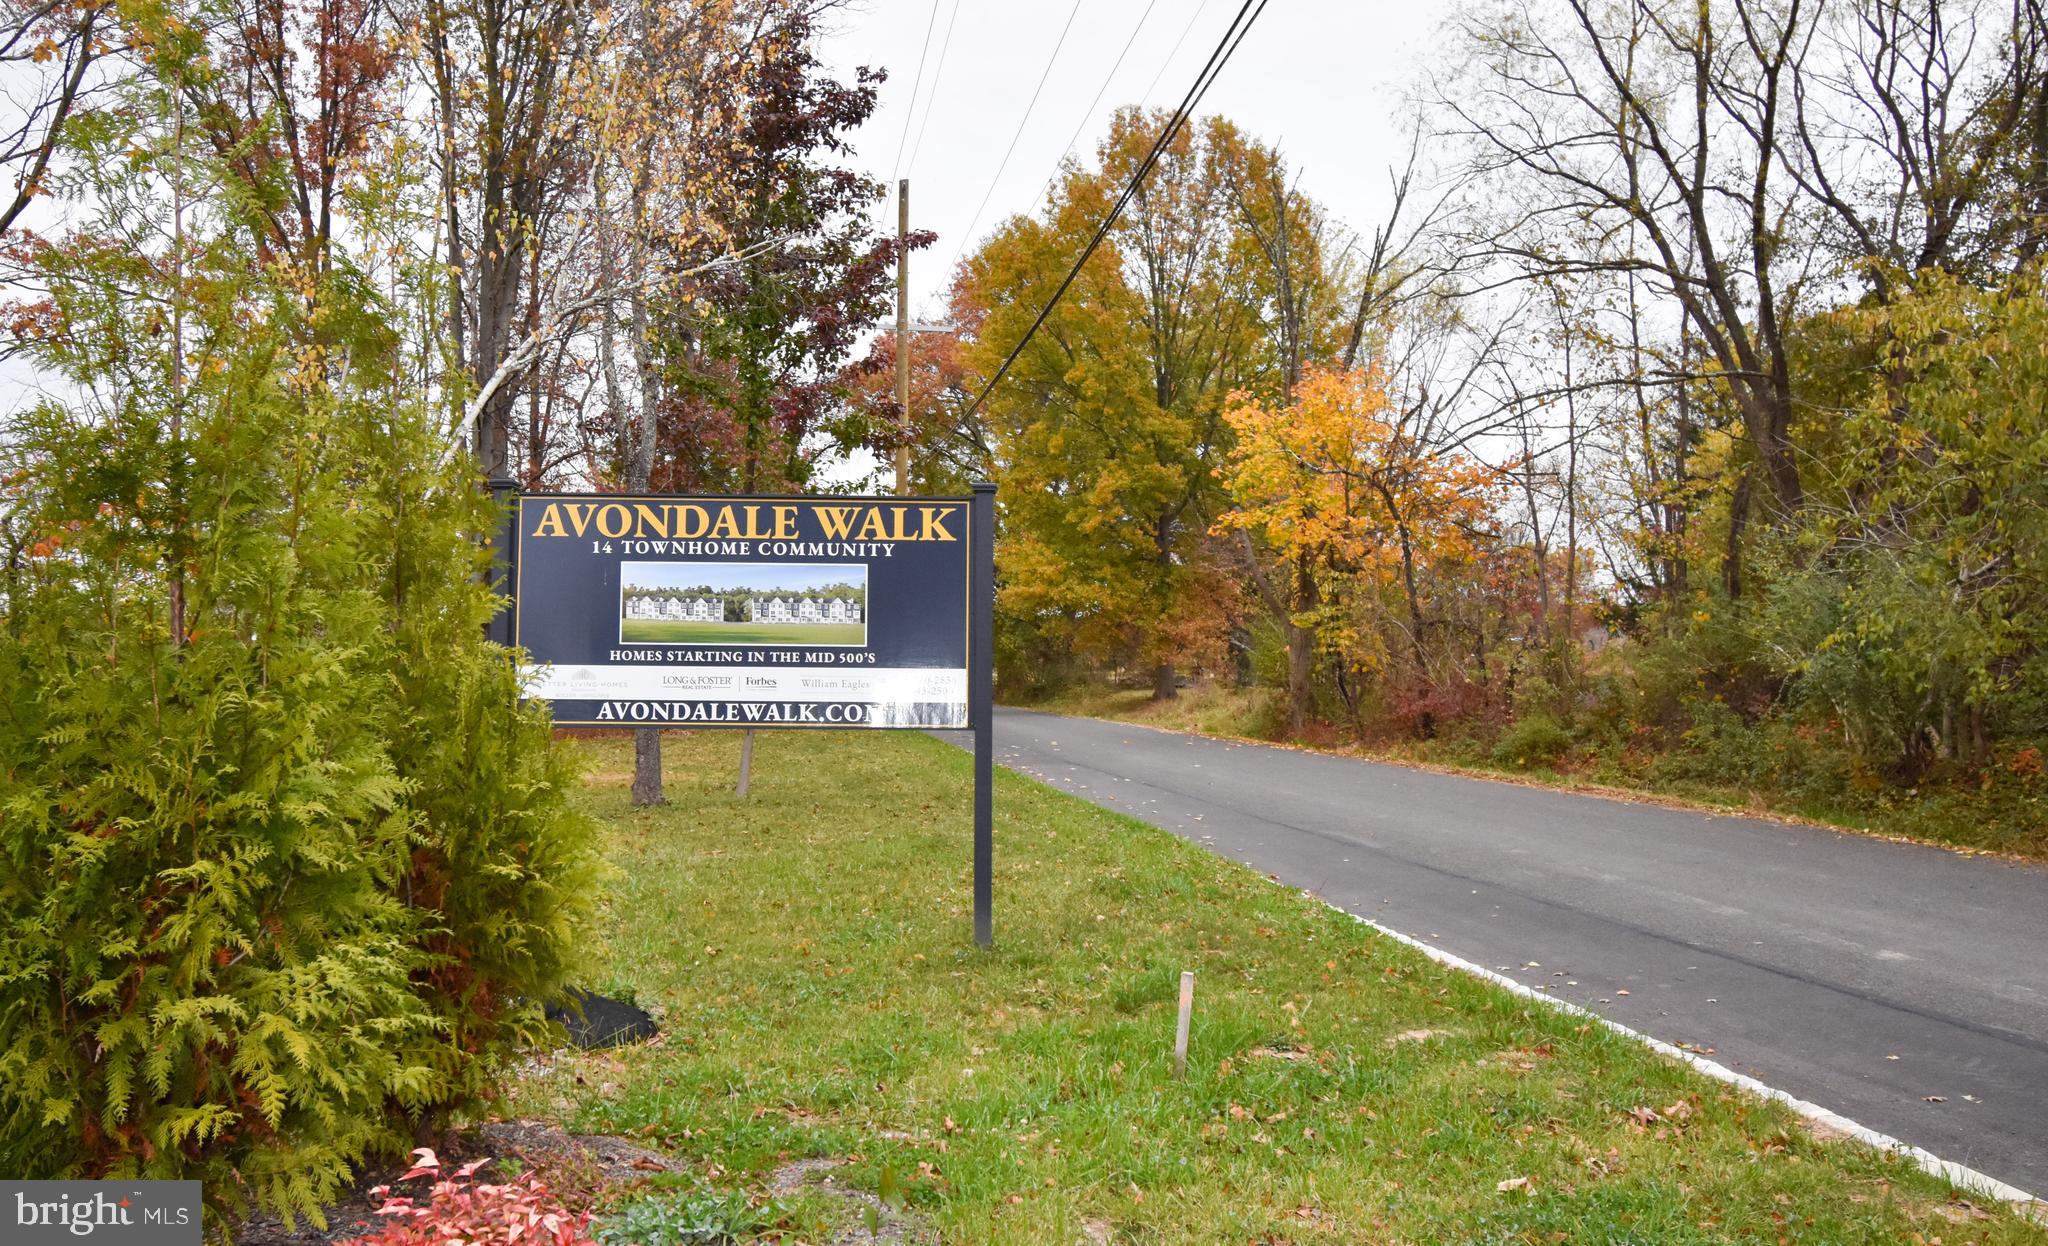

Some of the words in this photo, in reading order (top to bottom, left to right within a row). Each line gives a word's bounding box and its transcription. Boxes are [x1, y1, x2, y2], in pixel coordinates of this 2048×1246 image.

[532, 503, 799, 539] AVONDALE
[811, 506, 957, 542] WALK
[592, 540, 613, 555] 14
[621, 540, 750, 556] TOWNHOME
[758, 542, 896, 558] COMMUNITY
[610, 650, 662, 662] HOMES
[667, 650, 743, 663] STARTING
[747, 651, 764, 663] IN
[769, 652, 801, 664] THE
[804, 652, 835, 664] MID
[840, 652, 876, 664] 500'S
[663, 676, 689, 685] LONG
[697, 676, 731, 686] FOSTER
[746, 676, 777, 686] Forbes
[801, 678, 838, 688] William
